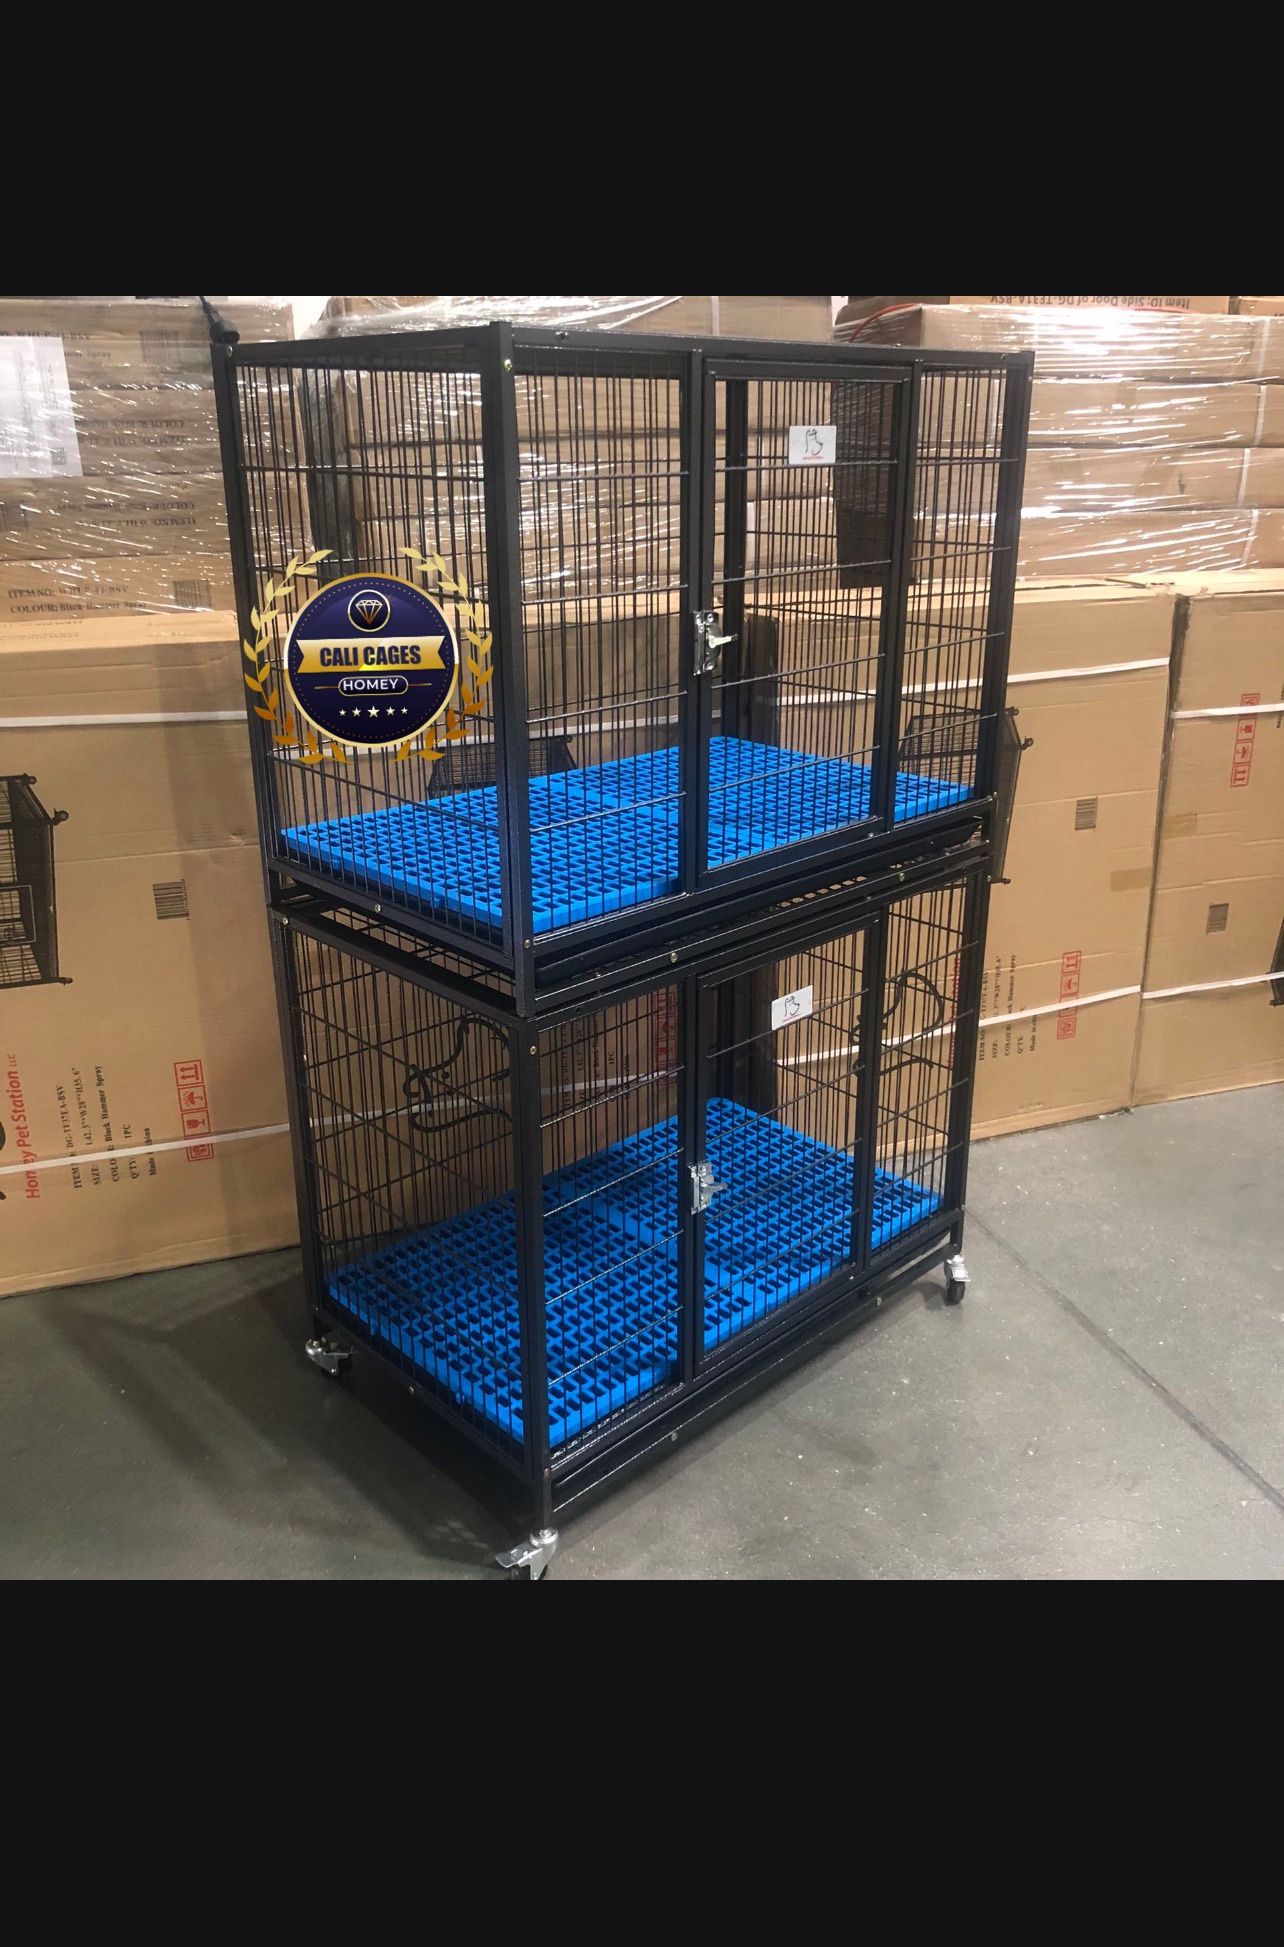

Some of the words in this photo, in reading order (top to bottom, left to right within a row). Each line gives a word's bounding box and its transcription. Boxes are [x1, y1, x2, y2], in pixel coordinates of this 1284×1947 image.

[8, 1054, 17, 1067] LLC
[95, 1065, 104, 1087] Spray
[6, 1070, 27, 1122] Station
[98, 1089, 109, 1120] Hammer
[15, 1123, 31, 1148] Pet
[102, 1121, 113, 1142] Black
[122, 1123, 132, 1139] 1PC
[107, 1144, 120, 1182] COLOR:
[147, 1157, 157, 1176] Made
[71, 1167, 82, 1189] ITEM
[91, 1164, 101, 1186] SIZE:
